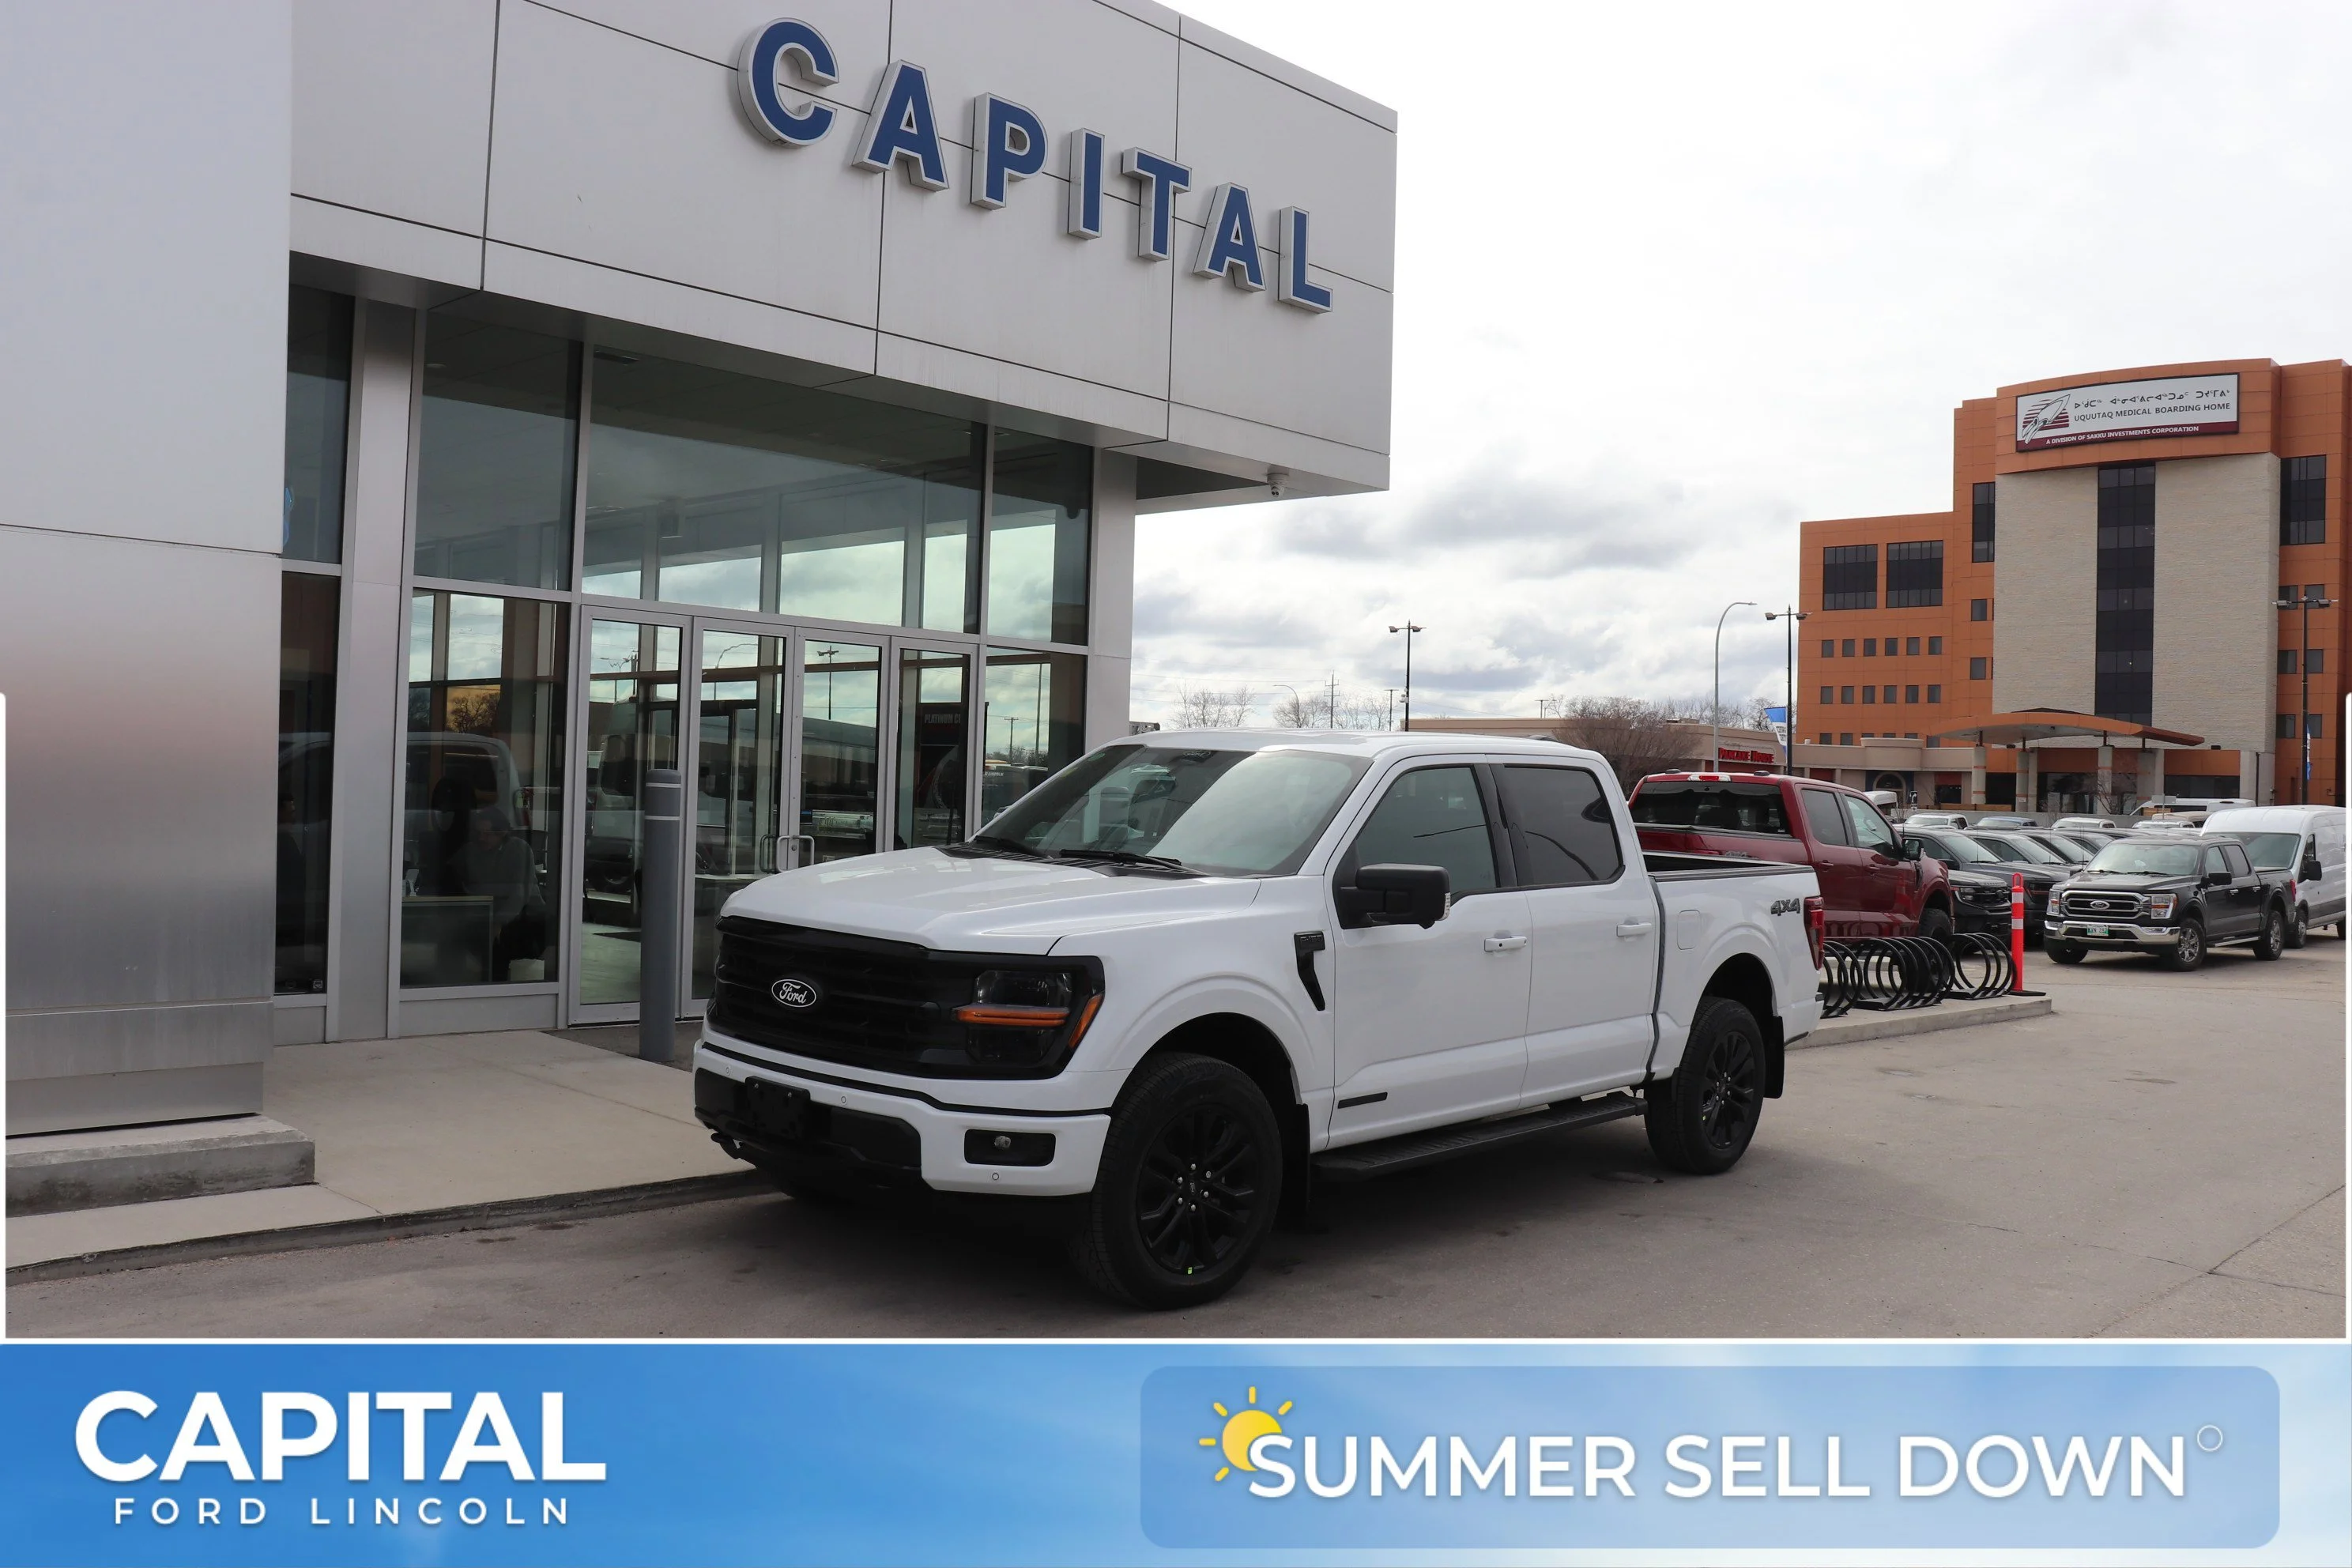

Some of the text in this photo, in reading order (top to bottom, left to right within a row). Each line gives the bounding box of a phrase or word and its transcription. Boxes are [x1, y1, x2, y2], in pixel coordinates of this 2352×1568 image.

[737, 17, 1334, 314] CAPITAL
[2074, 402, 2230, 422] UQUUTAQ MEDICAL BOARDING HOME
[2051, 435, 2077, 445] DIVISION
[2107, 428, 2150, 438] INVESTMENTS
[2151, 425, 2199, 435] CORPORATION
[1751, 750, 1774, 763] HOUSE
[779, 982, 808, 1004] Ford
